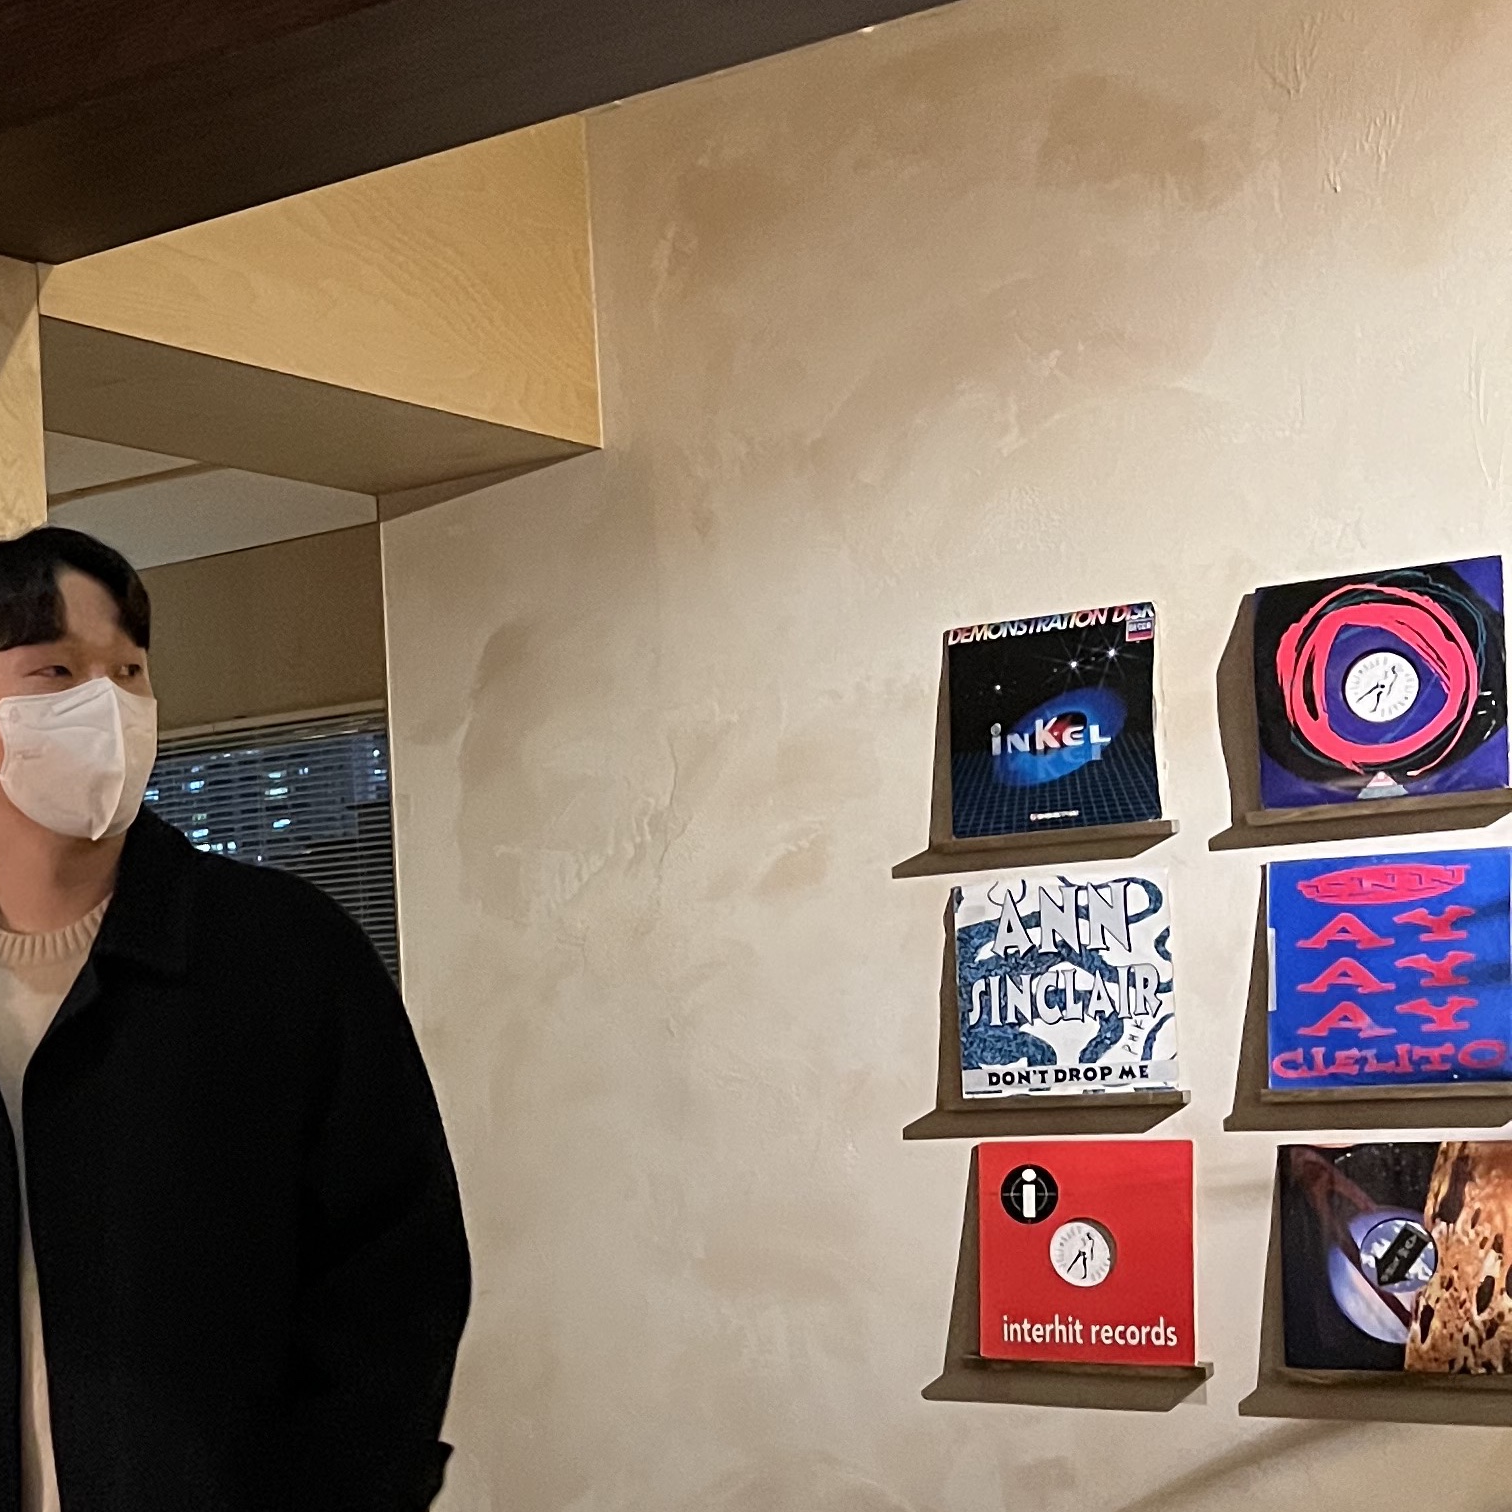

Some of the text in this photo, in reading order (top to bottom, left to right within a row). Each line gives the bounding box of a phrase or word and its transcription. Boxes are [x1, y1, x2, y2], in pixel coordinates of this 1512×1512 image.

[948, 605, 1155, 646] DEMONSTRATION DISK
[991, 880, 1132, 958] ANN
[969, 963, 1163, 1028] SINCLAIR
[988, 1064, 1149, 1086] DON'T DROP ME
[1272, 1039, 1507, 1078] CIELITO
[1003, 1313, 1178, 1347] interhit records
